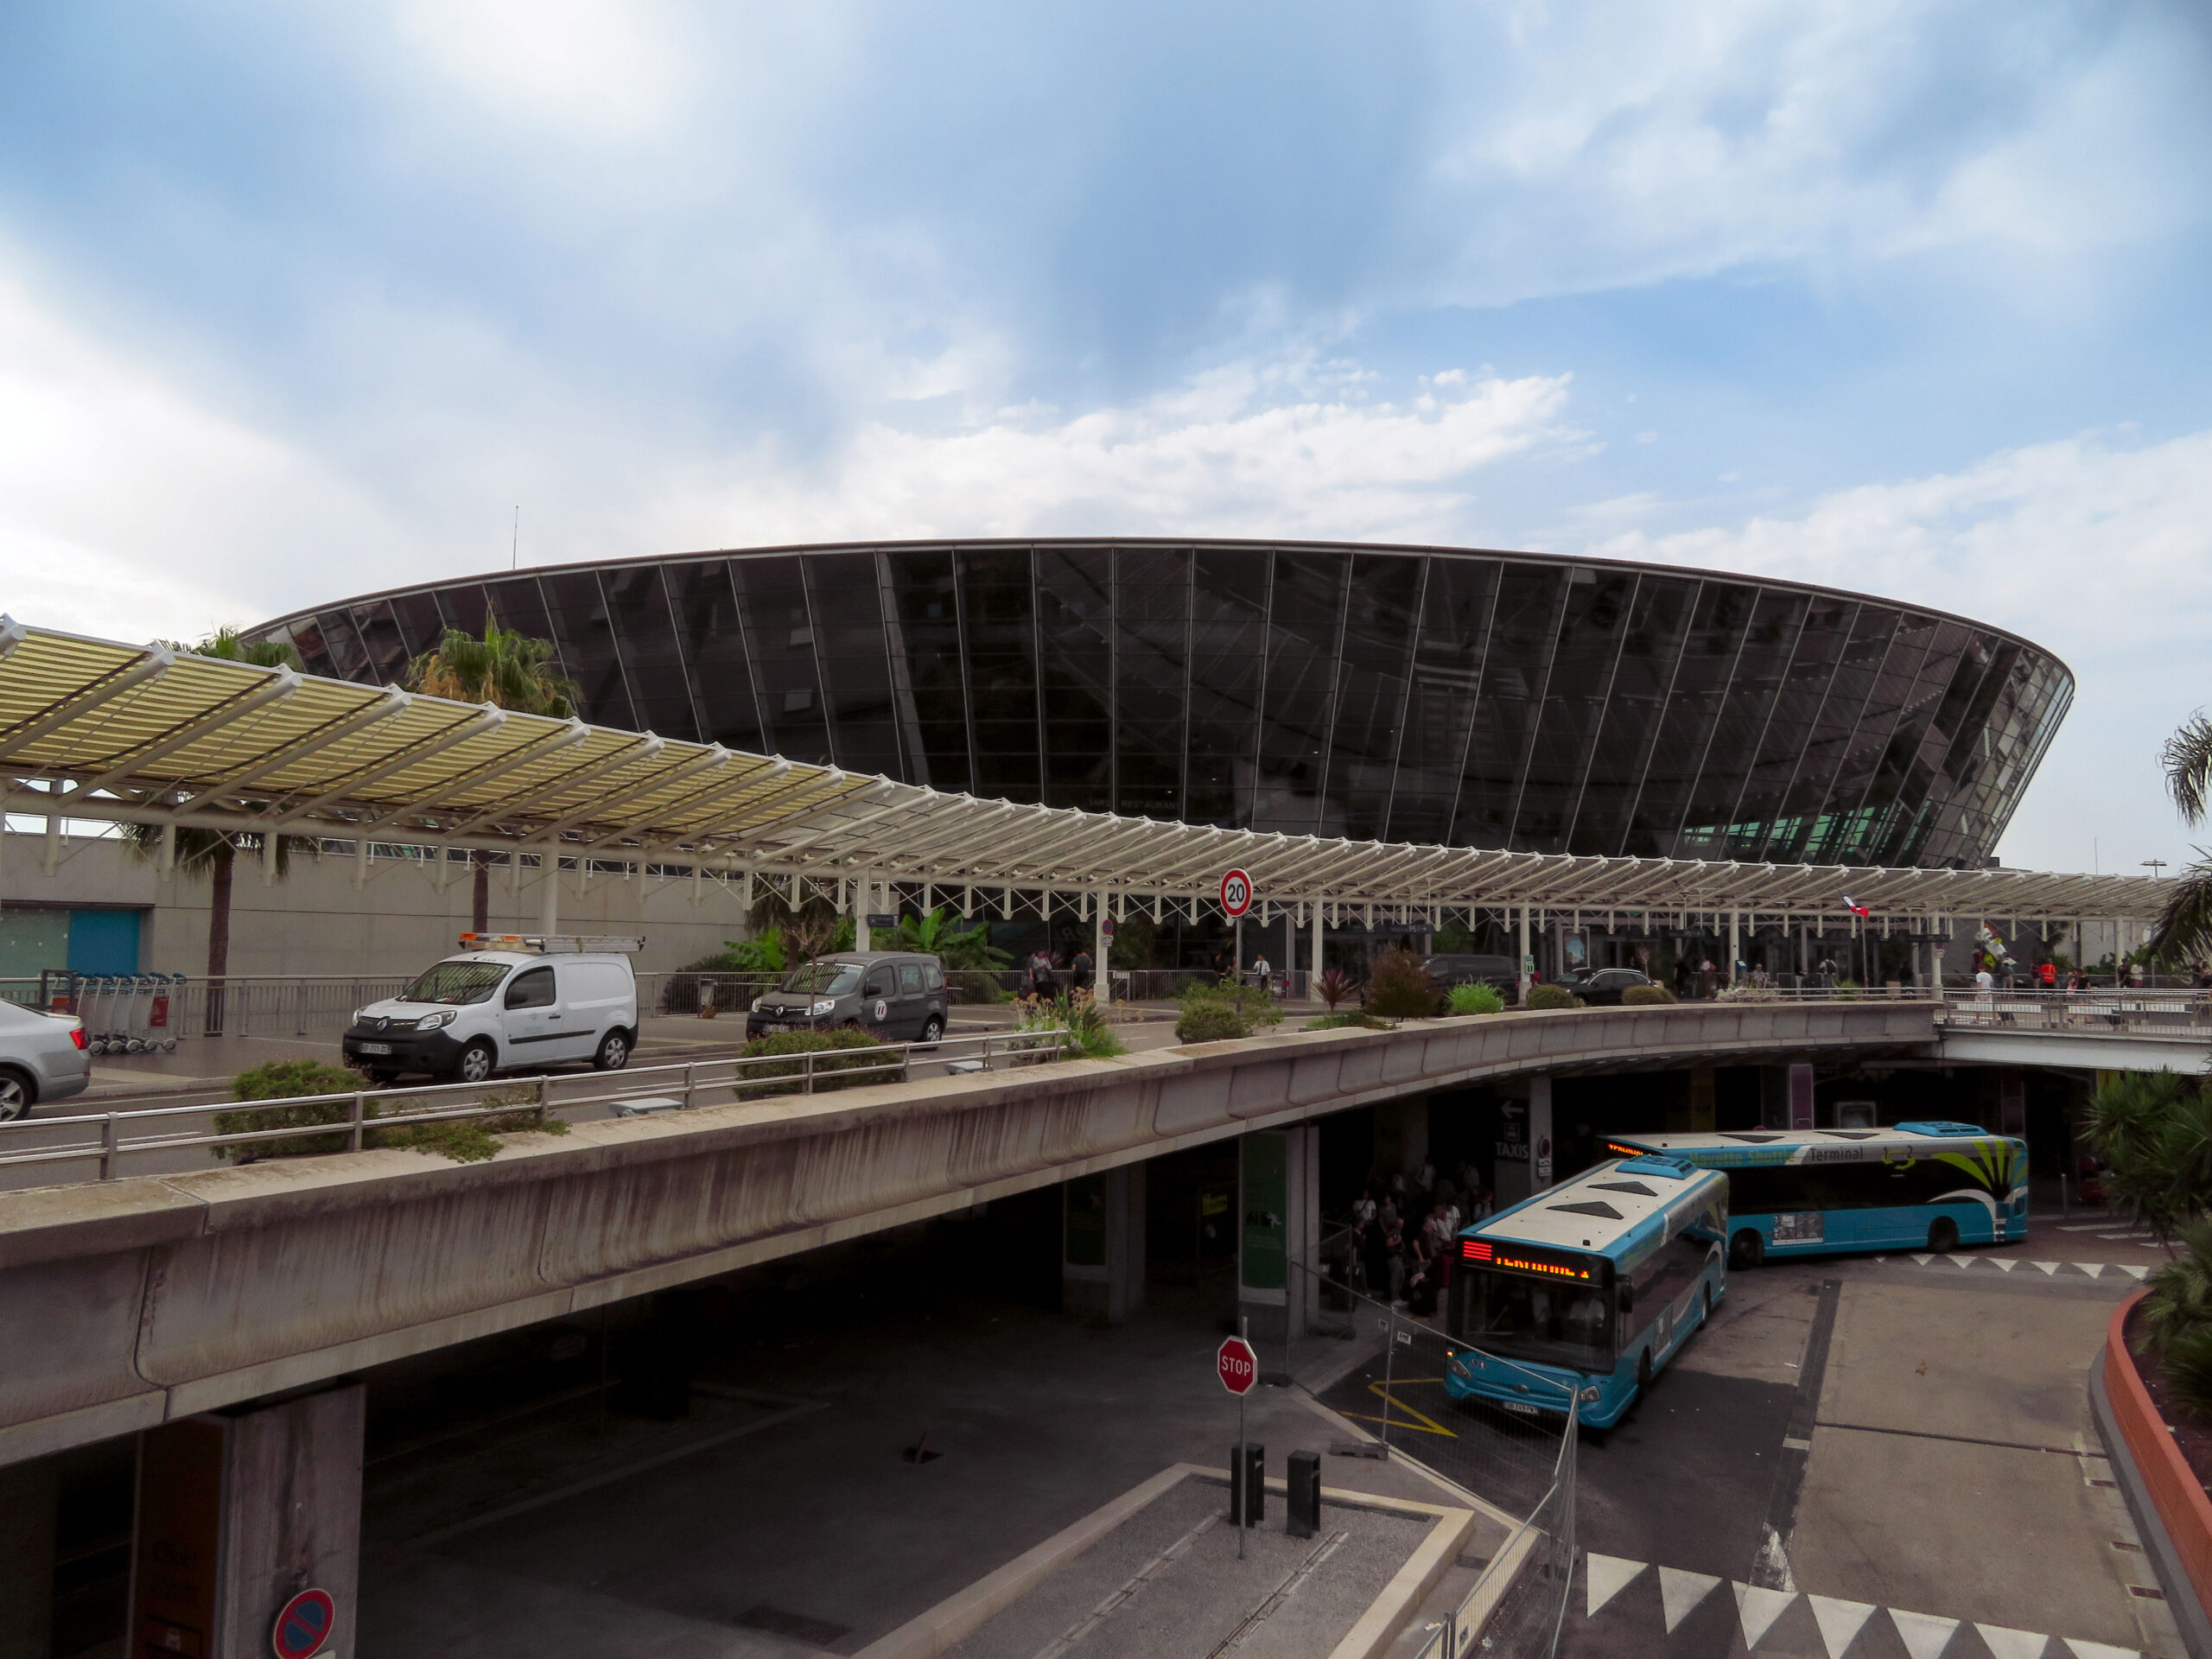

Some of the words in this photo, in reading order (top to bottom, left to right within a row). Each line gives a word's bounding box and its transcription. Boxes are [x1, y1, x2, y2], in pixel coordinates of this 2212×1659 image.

[1227, 883, 1245, 903] 20
[1495, 1141, 1529, 1160] TAXIS
[1689, 1152, 1742, 1166] Navette
[1748, 1149, 1795, 1165] Shuttle
[1810, 1147, 1863, 1162] Terminal
[1883, 1147, 1889, 1159] 1
[1906, 1146, 1913, 1159] 2
[1221, 1355, 1251, 1376] STOP
